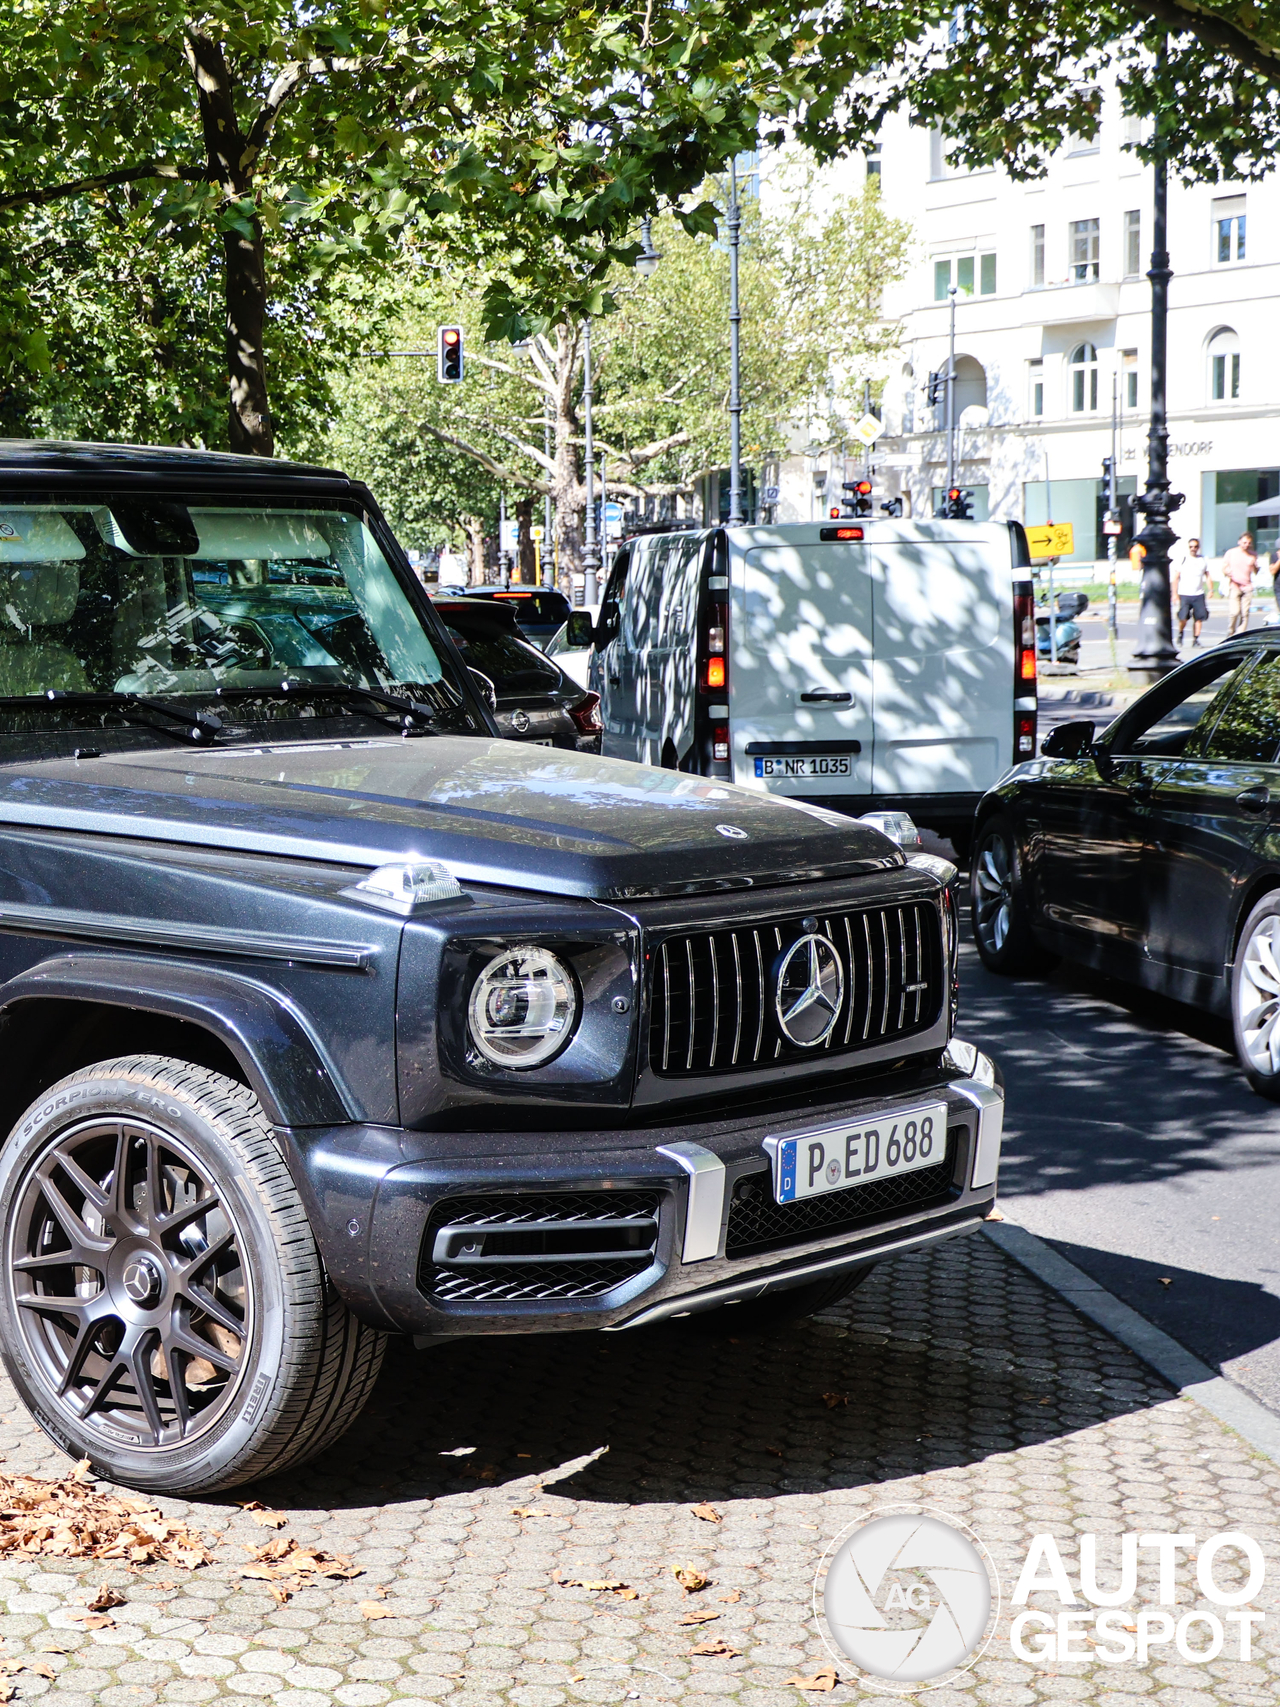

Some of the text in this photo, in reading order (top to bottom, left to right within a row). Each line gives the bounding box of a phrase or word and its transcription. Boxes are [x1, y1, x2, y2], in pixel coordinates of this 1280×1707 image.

[764, 758, 848, 775] B NR 1035
[23, 1086, 182, 1138] SCORPION ZERO
[808, 1116, 934, 1187] P ED 688
[784, 1177, 791, 1190] D
[241, 1371, 272, 1426] PIRELLI
